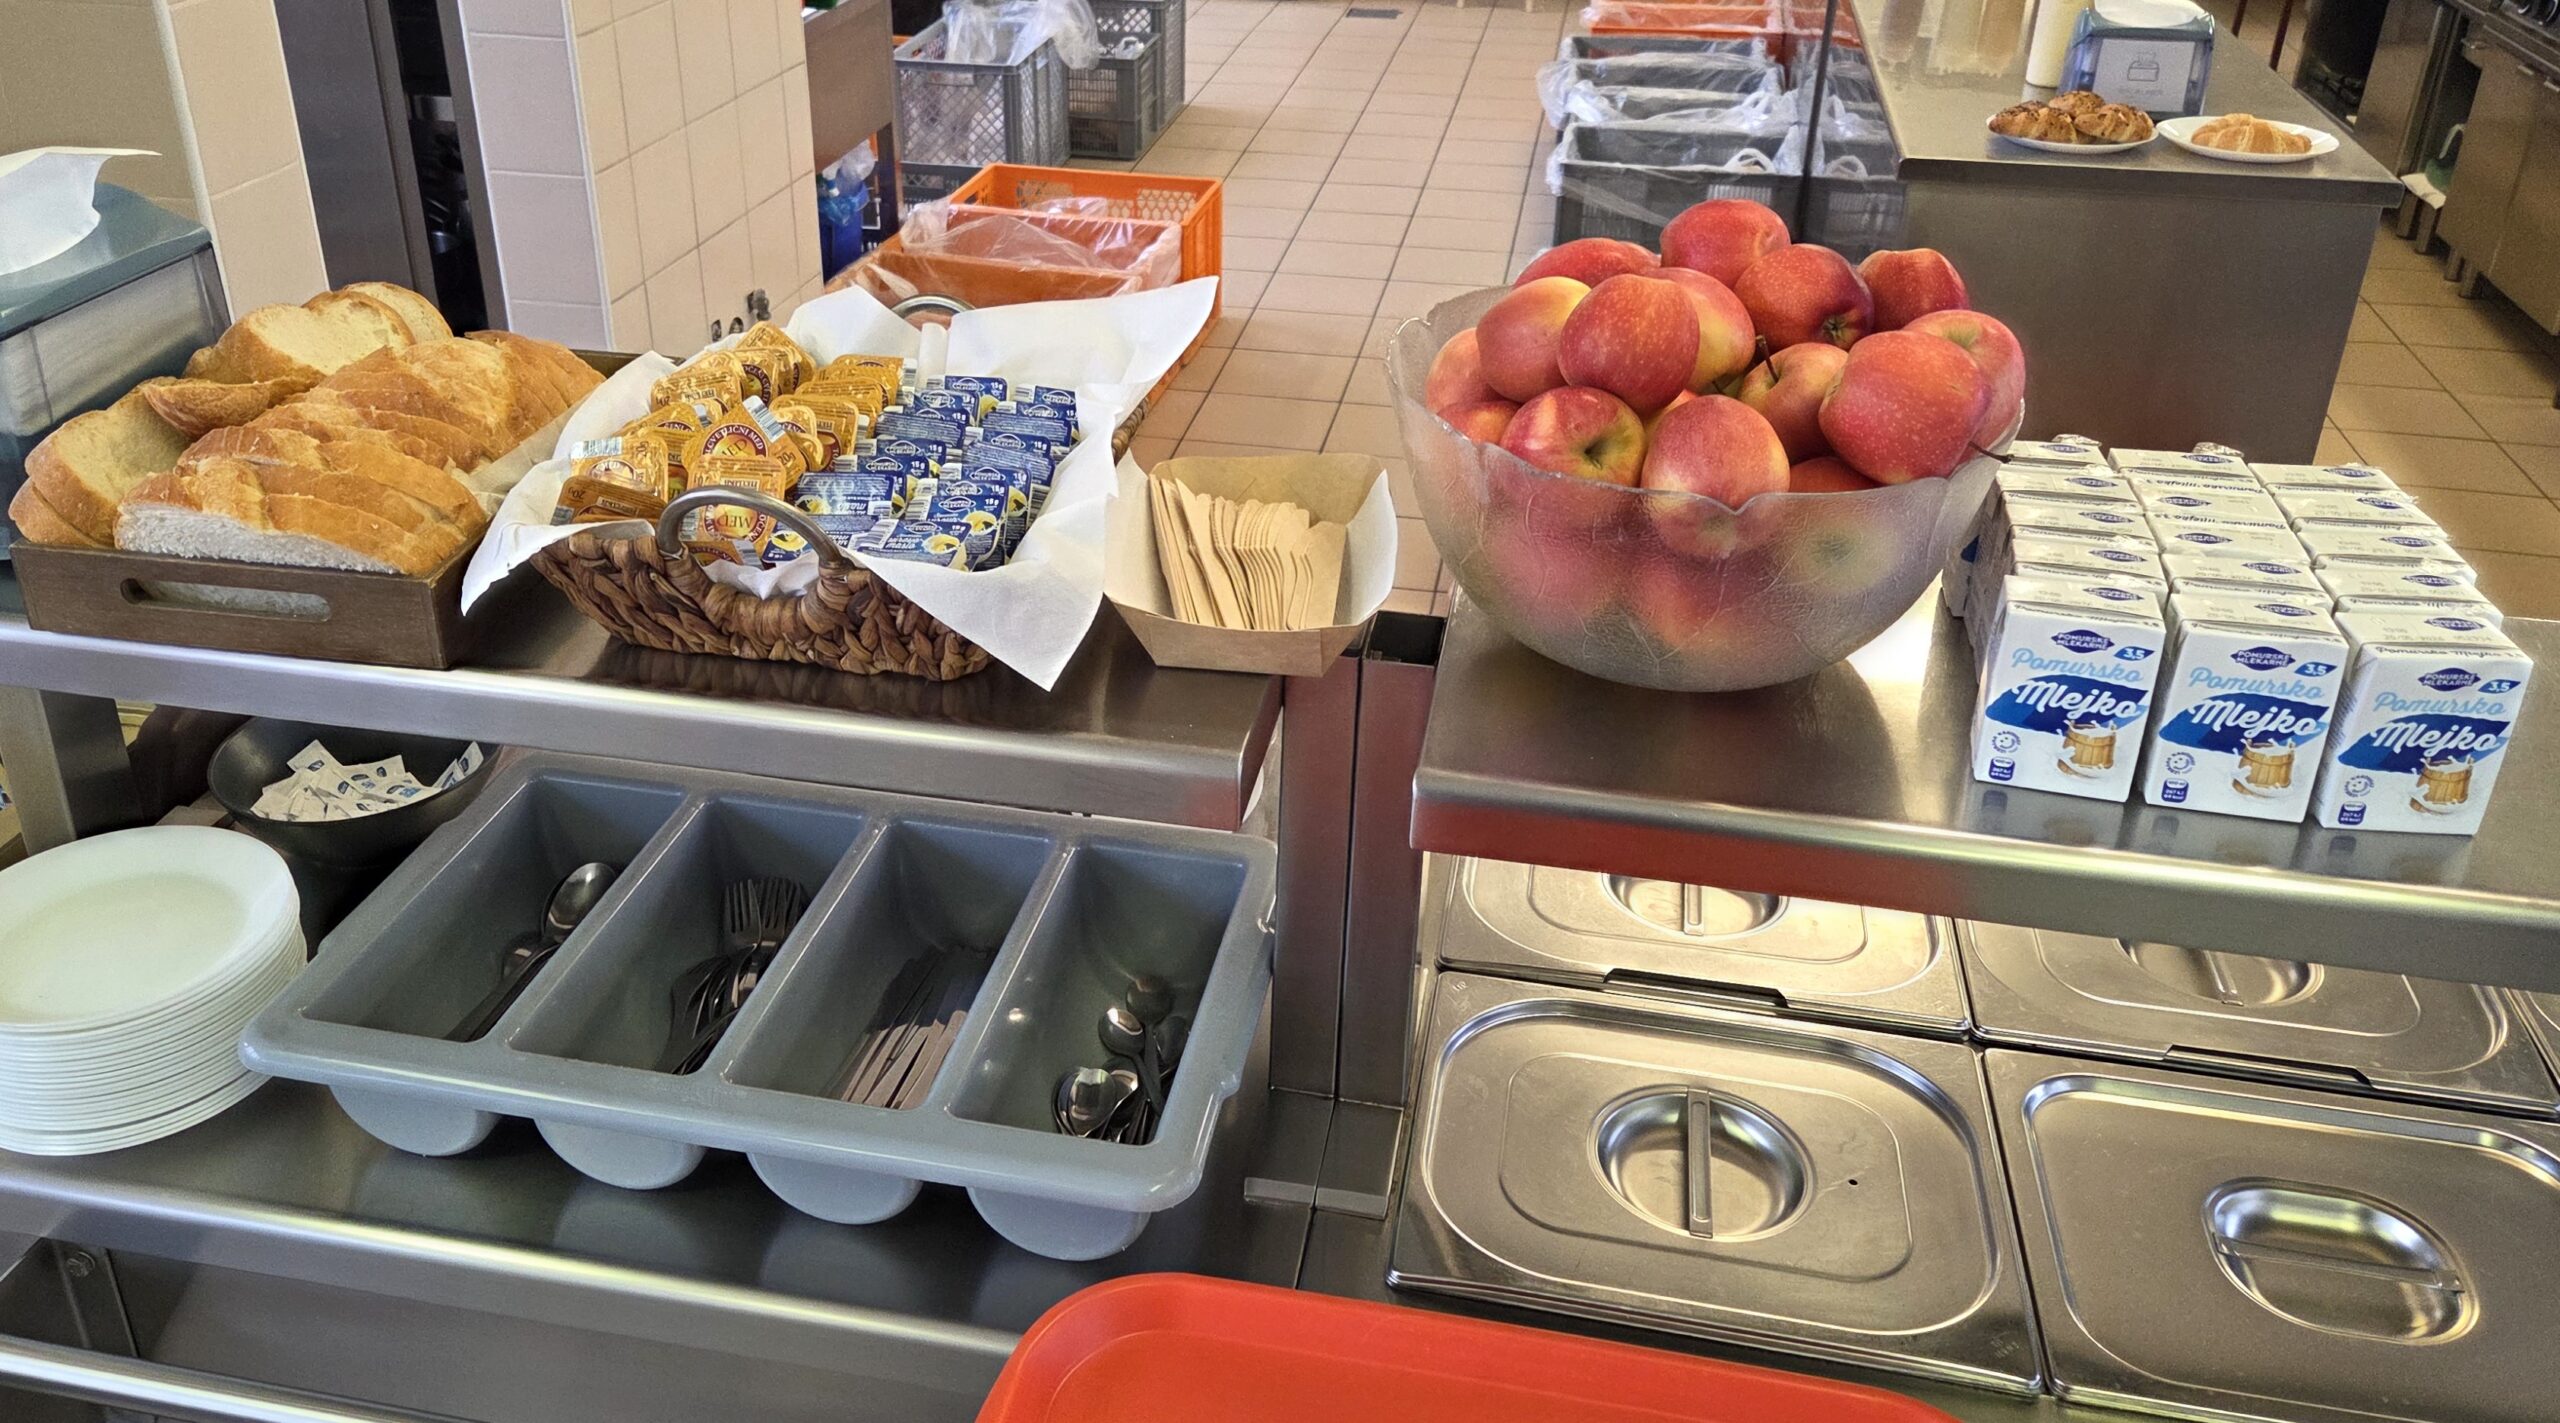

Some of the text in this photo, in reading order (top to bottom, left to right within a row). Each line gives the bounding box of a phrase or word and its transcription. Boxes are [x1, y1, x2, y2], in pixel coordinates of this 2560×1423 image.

[2056, 639, 2107, 650] MLEKARNE
[2058, 633, 2110, 645] POMURSKE
[2122, 648, 2145, 661] 3,5
[2238, 650, 2290, 662] POMURSKE
[2011, 648, 2144, 683] Pomursko
[2235, 657, 2288, 667] MLEKARNE
[2304, 663, 2328, 676] 3,5
[2188, 666, 2325, 699] Pomursko
[2422, 679, 2474, 687] MLEKARNE
[2425, 672, 2476, 683] POMURSKE
[2489, 681, 2511, 693] 3,5
[2011, 680, 2143, 719] Mlejko
[2373, 691, 2507, 716] Pomursko
[2187, 699, 2322, 738] Mlejko
[2370, 722, 2502, 757] Mlejko
